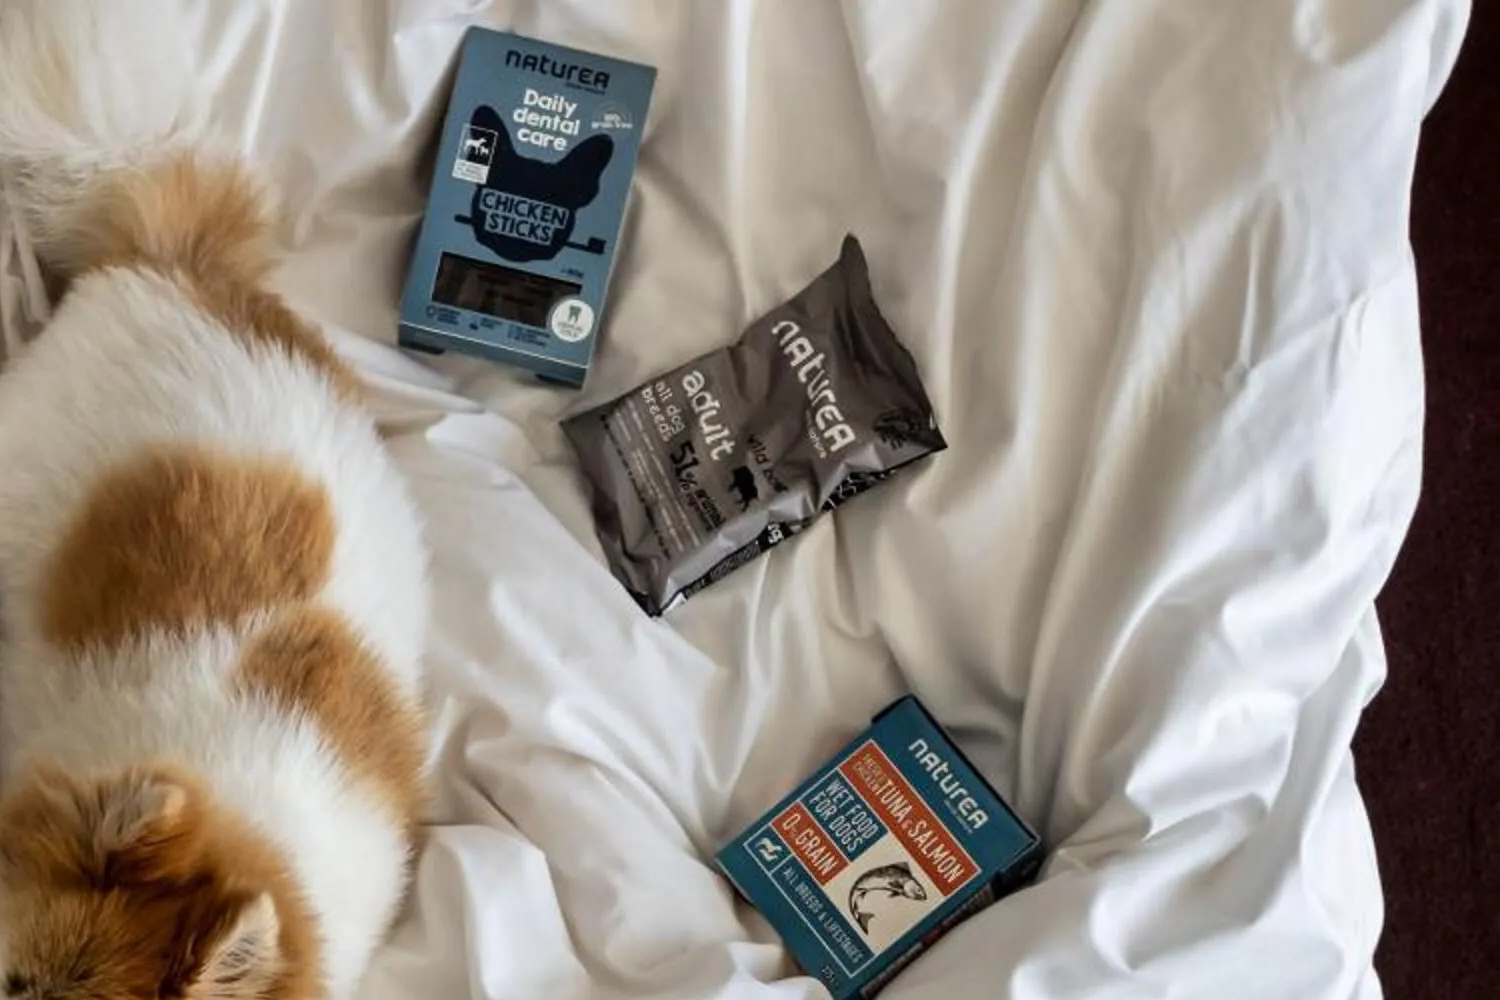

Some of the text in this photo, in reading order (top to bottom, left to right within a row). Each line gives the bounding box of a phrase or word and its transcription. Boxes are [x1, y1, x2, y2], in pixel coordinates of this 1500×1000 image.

[514, 108, 580, 135] dental
[524, 89, 576, 118] Daily
[518, 128, 566, 150] care
[481, 191, 567, 227] CHICKEN
[488, 212, 550, 242] STICKS
[656, 382, 684, 434] all dog
[683, 371, 734, 460] adult
[808, 790, 864, 852] FOR DOGS
[823, 778, 856, 811] WET
[844, 803, 880, 840] FOOD
[873, 780, 915, 823] TUNA
[905, 819, 965, 884] SALMON
[793, 827, 838, 875] GRAIN
